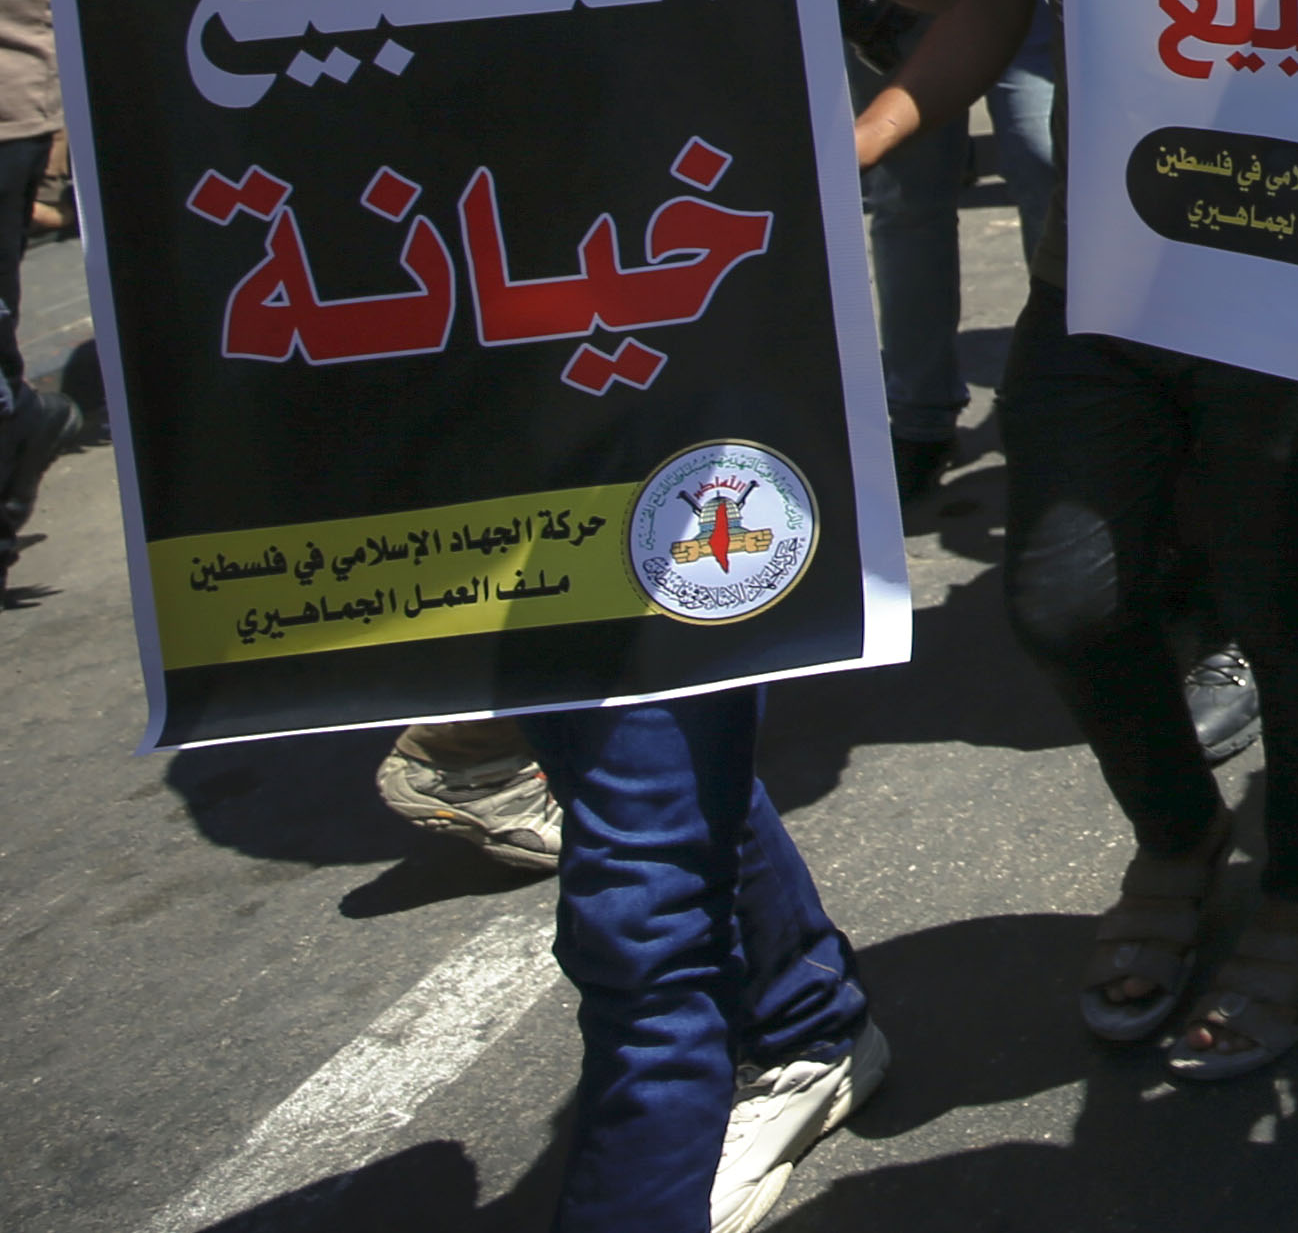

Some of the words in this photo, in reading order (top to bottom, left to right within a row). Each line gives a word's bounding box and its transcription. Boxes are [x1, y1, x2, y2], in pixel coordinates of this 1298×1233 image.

[1156, 145, 1233, 178] فلسطين
[1237, 154, 1261, 192] في
[186, 136, 773, 396] خيانة
[448, 517, 533, 555] الجهاد
[536, 508, 607, 547] حركة
[190, 544, 287, 594] فلسطين
[294, 540, 326, 585] في
[332, 528, 442, 582] الإسلامي
[404, 575, 489, 619] العمل
[496, 568, 571, 601] ملف
[236, 587, 396, 645] الجماهيري
